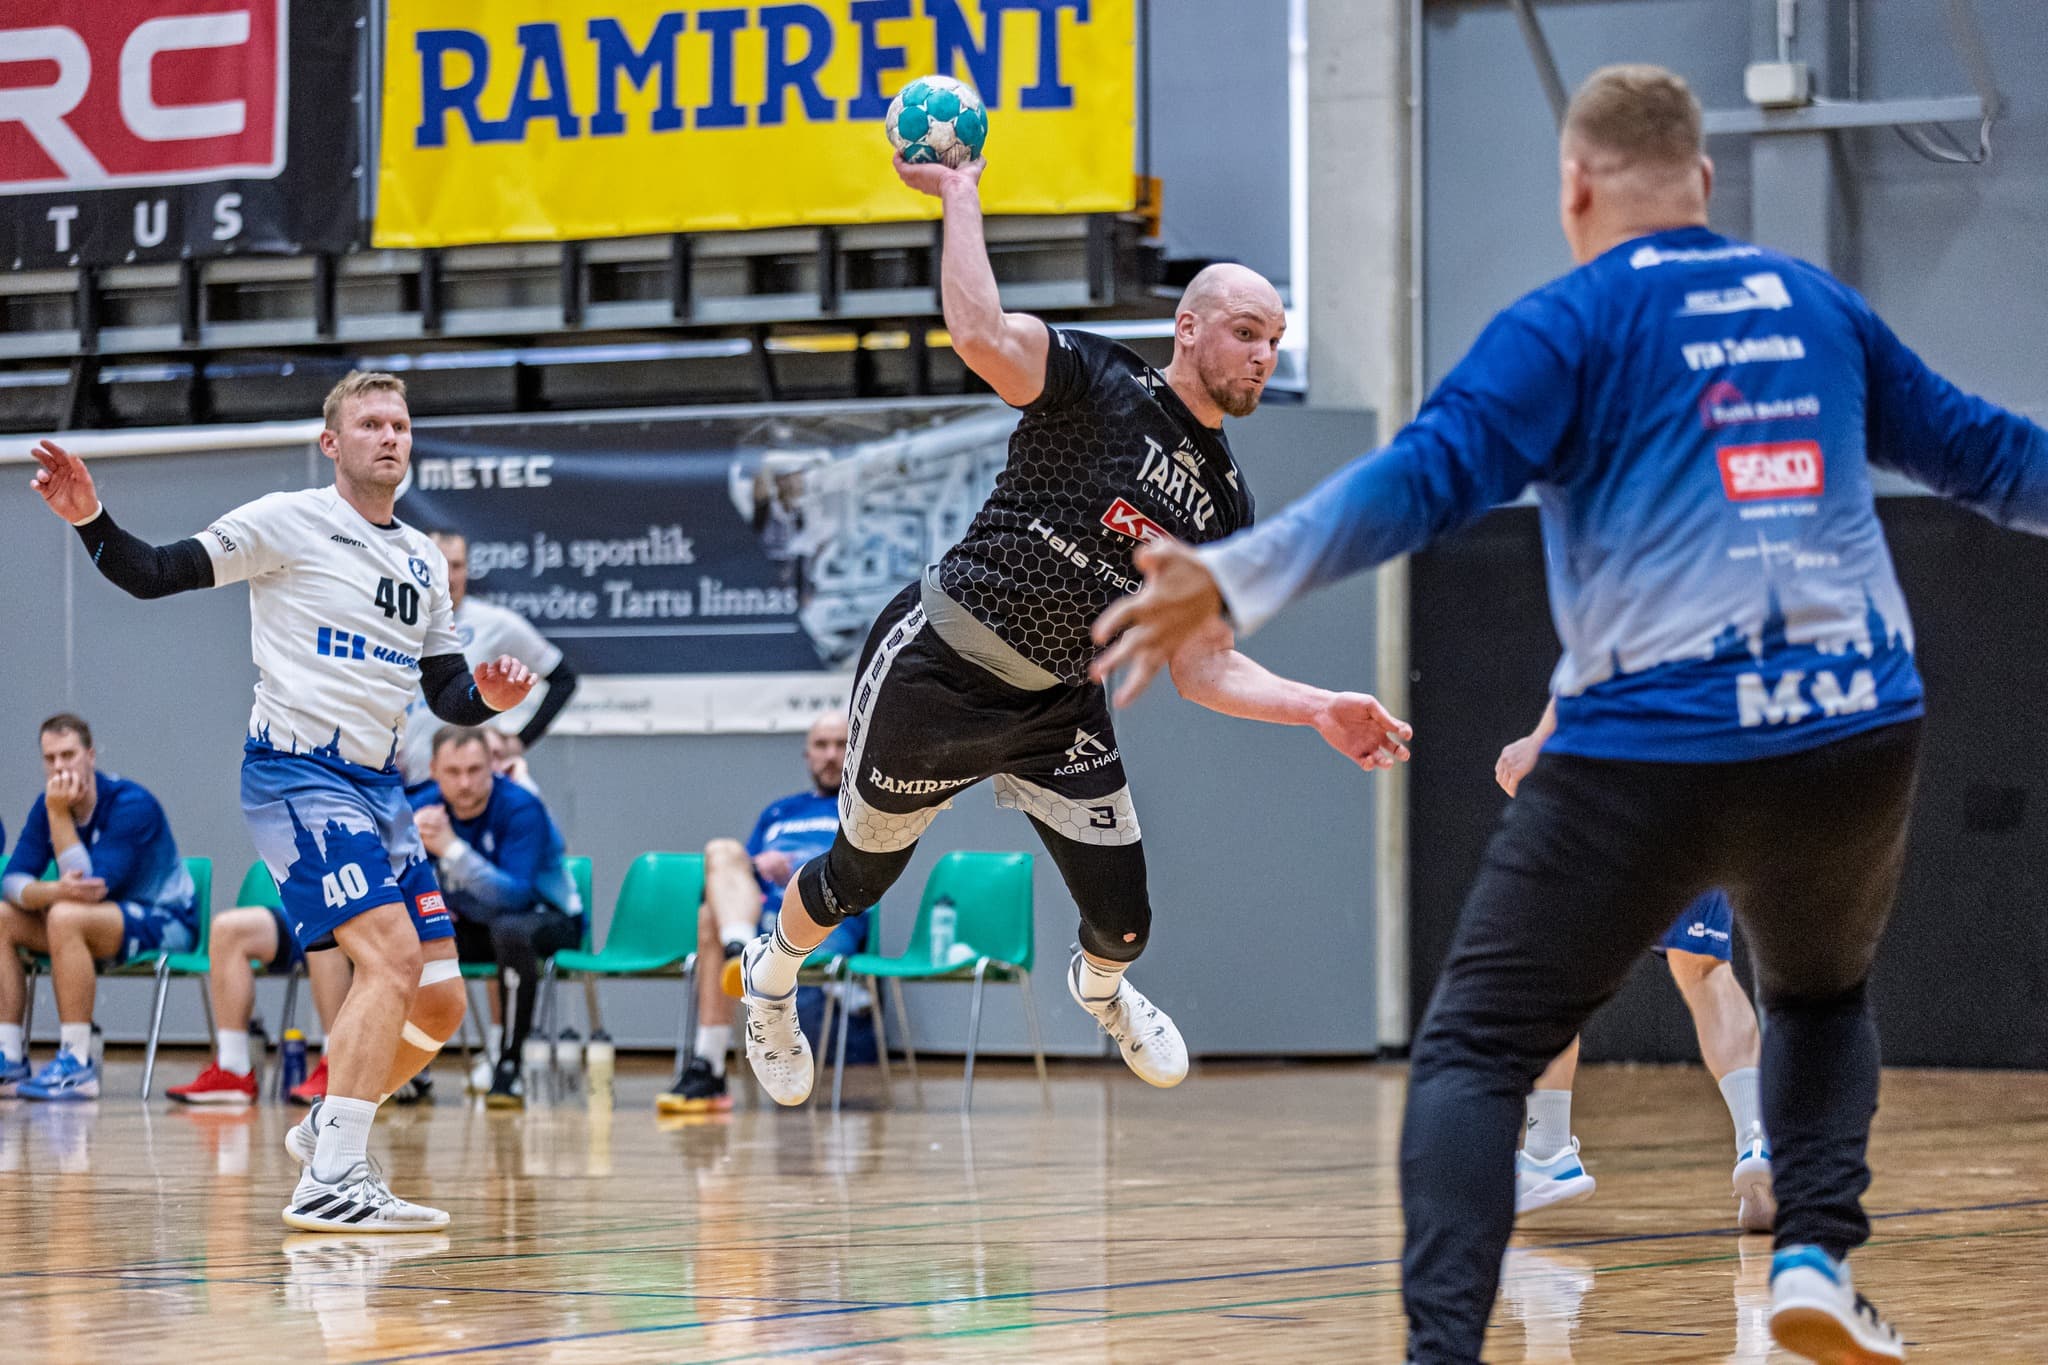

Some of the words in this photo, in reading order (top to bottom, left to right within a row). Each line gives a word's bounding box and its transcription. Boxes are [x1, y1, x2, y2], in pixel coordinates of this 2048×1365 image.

[414, 0, 1090, 149] RAMIRENT
[418, 455, 554, 490] METEC
[1136, 435, 1215, 532] TARTU
[531, 531, 564, 579] ja
[567, 525, 695, 577] sportlik
[1027, 518, 1090, 569] Hals
[374, 576, 420, 626] 40
[603, 578, 692, 618] Tartu
[699, 575, 799, 616] linnas
[1053, 760, 1091, 776] AGRI
[1087, 805, 1118, 829] 3
[321, 862, 369, 909] 40
